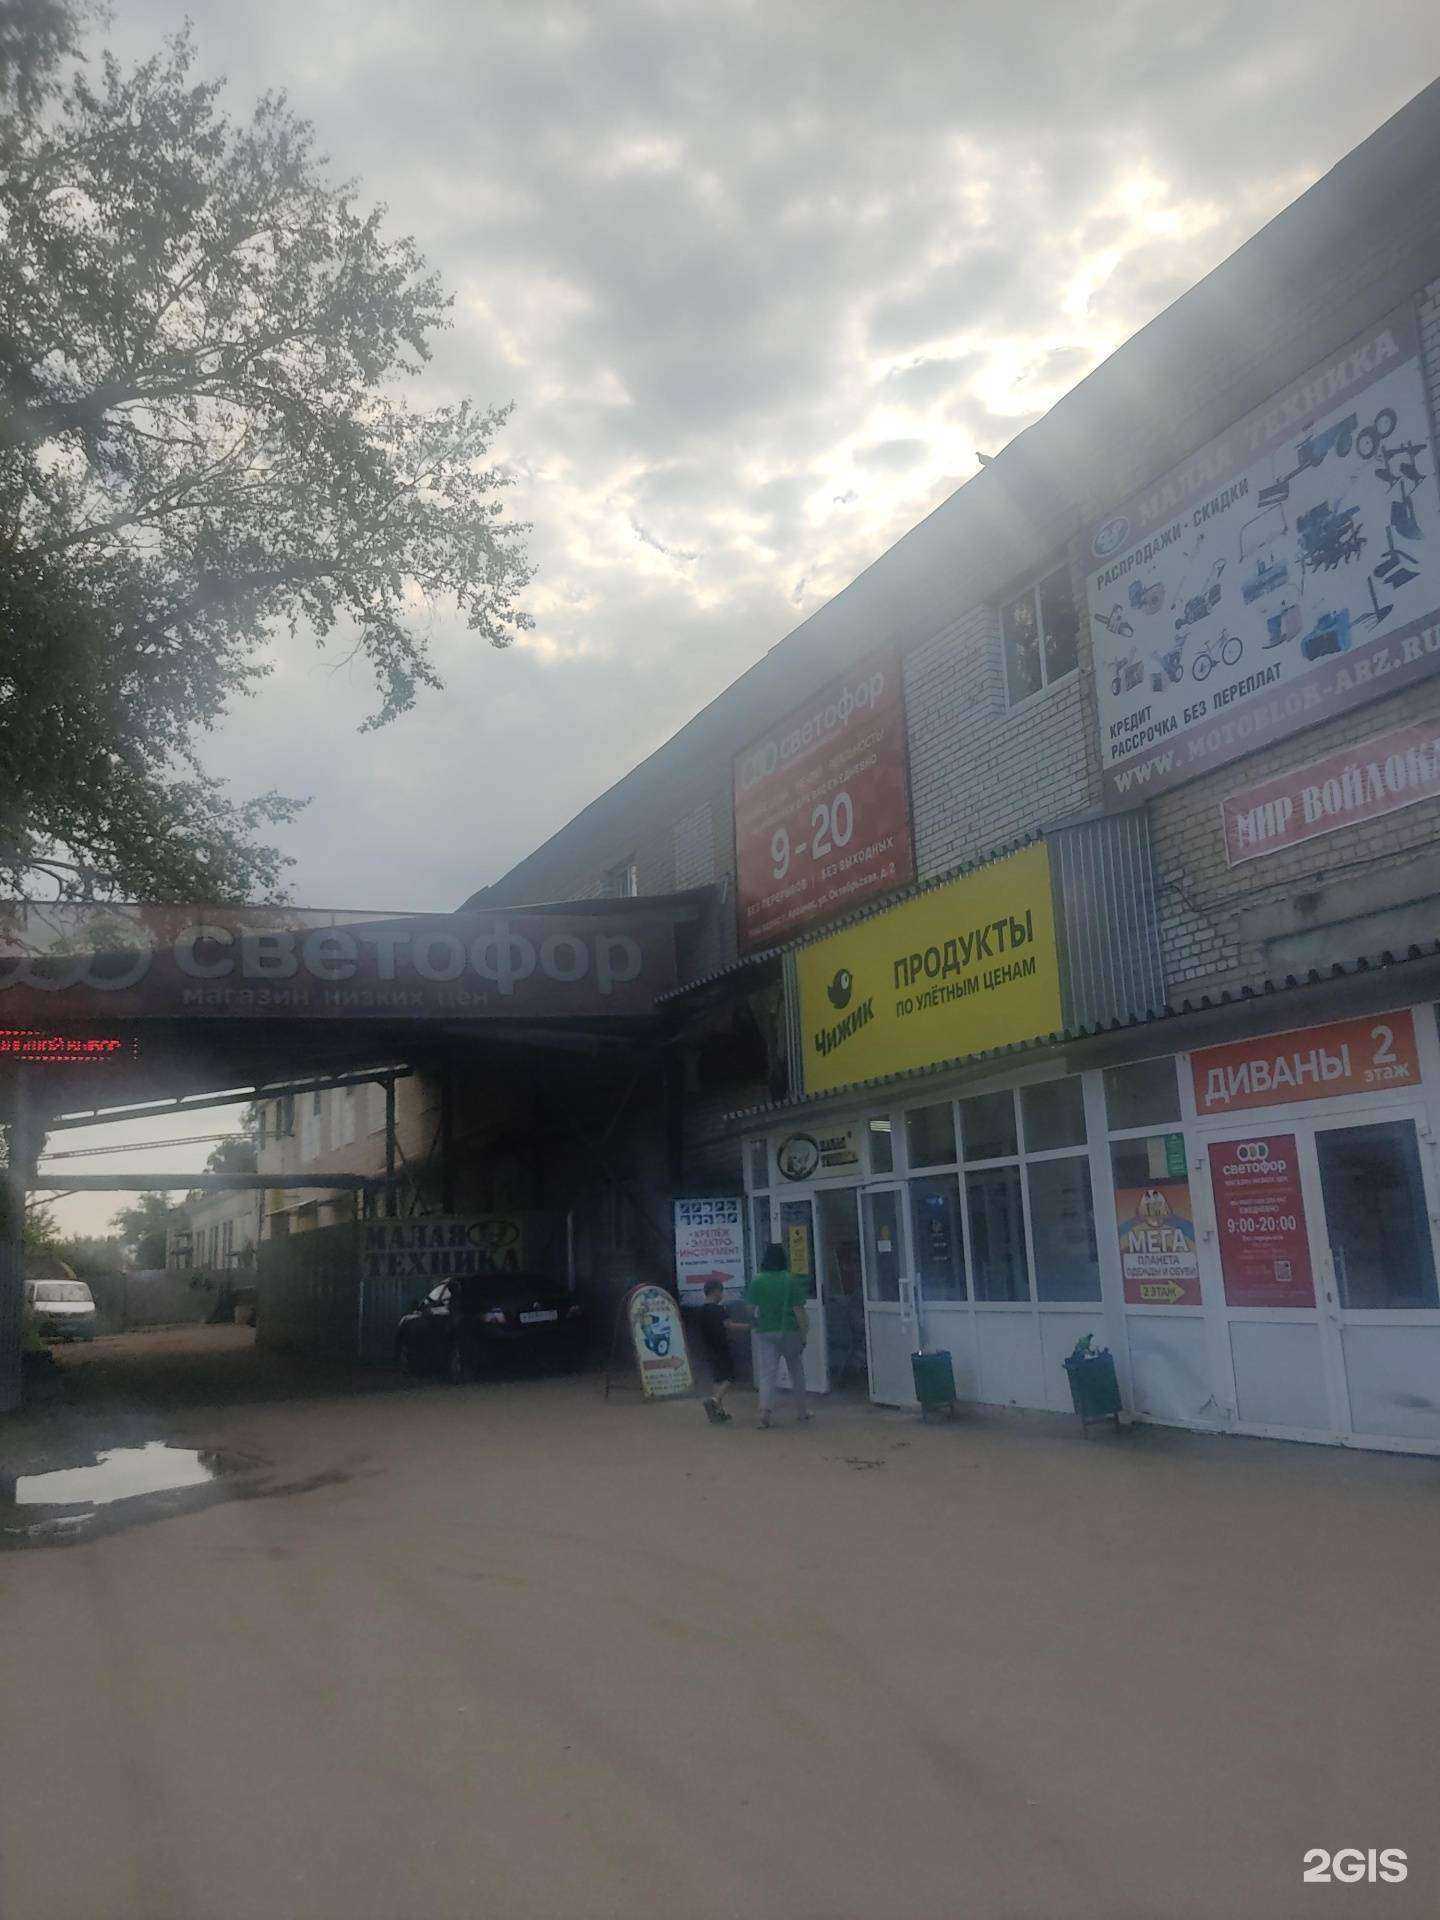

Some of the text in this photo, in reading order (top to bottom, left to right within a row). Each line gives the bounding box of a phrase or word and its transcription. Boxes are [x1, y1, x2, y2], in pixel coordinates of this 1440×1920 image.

[1249, 328, 1401, 447] ТЕХНИКА
[1096, 477, 1250, 591] РАСПРОДАЖИ СКИДКИ
[779, 671, 884, 759] светофор
[1109, 704, 1153, 738] КРЕДИТ
[1110, 662, 1282, 759] РАССРОЧКА БЕЗ ПЕРЕПЛАТ
[1237, 796, 1292, 850] МИР
[174, 920, 644, 997] светофор
[893, 909, 1034, 989] ПРОДУКТЫ
[182, 985, 489, 1009] магазин низких цен
[896, 956, 1036, 1020] ПО УЛЁТНЫМ ЦЕНАМ
[1204, 1024, 1396, 1106] ДИВАНЫ 2
[1363, 1063, 1410, 1083] этаж
[1223, 1160, 1287, 1175] светофор
[365, 1224, 468, 1251] МАЛАЯ
[1128, 1229, 1190, 1253] МЕГА
[1227, 1215, 1297, 1233] 9:00-20:00
[365, 1250, 521, 1277] ТЕХНИКА
